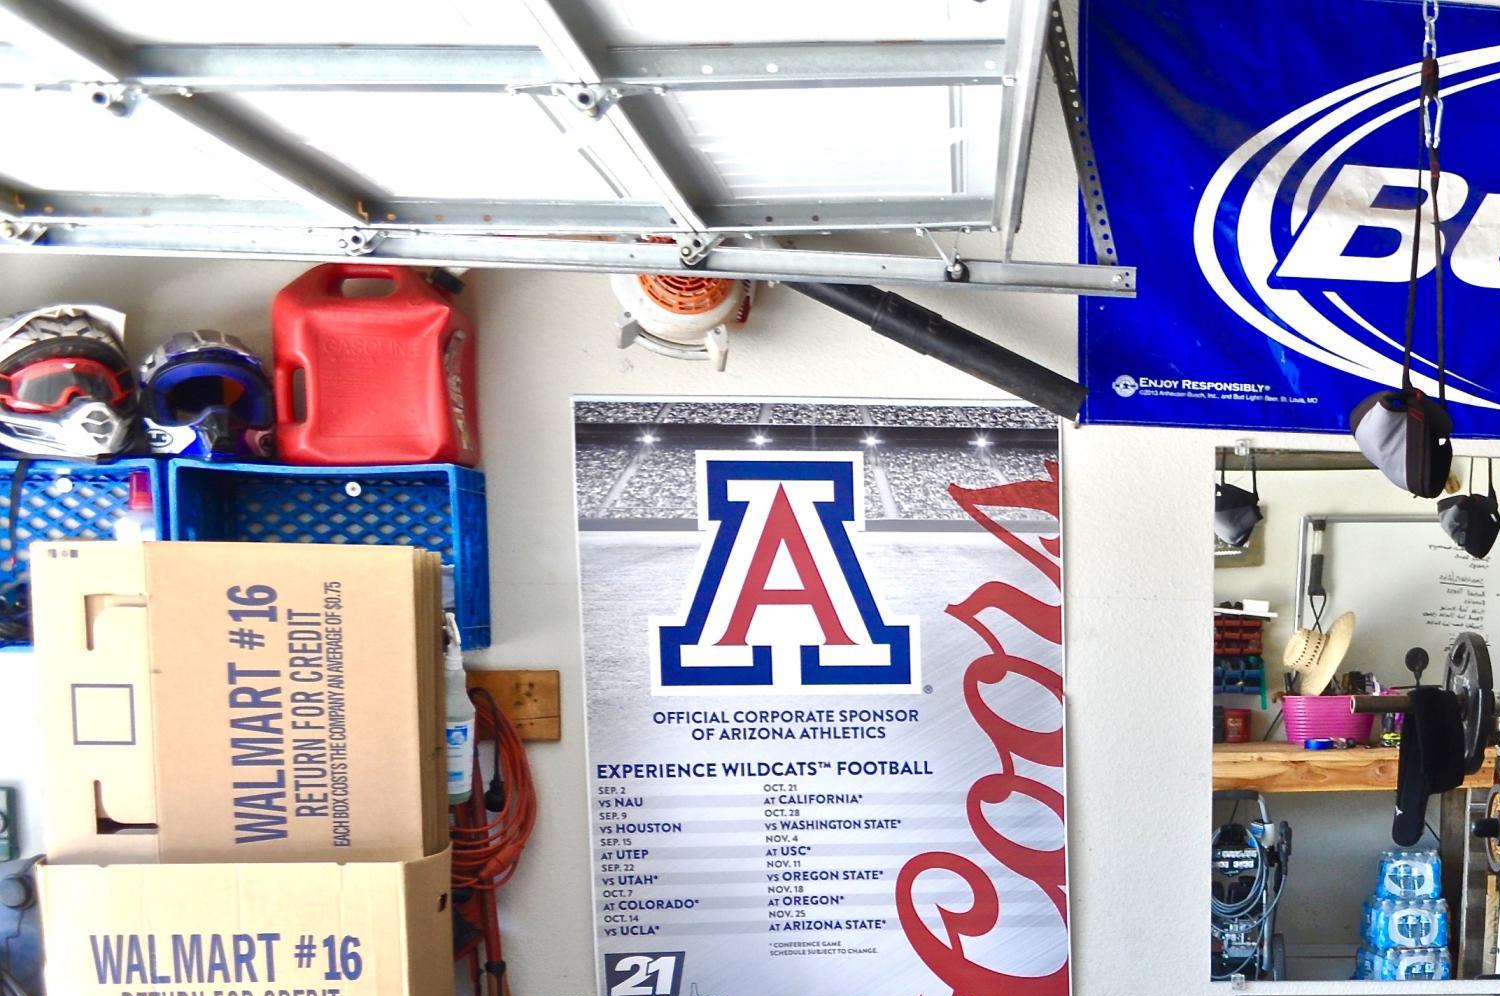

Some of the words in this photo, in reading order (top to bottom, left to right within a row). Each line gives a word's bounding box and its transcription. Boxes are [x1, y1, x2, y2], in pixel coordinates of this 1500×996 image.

[1139, 377, 1179, 389] ENJOY
[655, 455, 915, 690] A
[323, 581, 342, 610] $0.75
[324, 611, 342, 626] OF
[287, 608, 323, 683] CREDIT
[325, 627, 343, 674] AVERAGE
[326, 674, 344, 690] AN
[289, 691, 326, 730] FOR
[327, 690, 346, 741] COMPANY
[653, 711, 729, 725] OFFICIAL
[733, 710, 835, 724] CORPORATE
[839, 709, 919, 723] SPONSOR
[692, 728, 715, 741] OF
[719, 727, 796, 740] ARIZONA
[800, 726, 886, 740] ATHLETICS
[228, 662, 288, 845] WALMART
[328, 742, 347, 761] THE
[597, 763, 717, 779] EXPERIENCE
[837, 760, 933, 776] FOOTBALL
[292, 738, 329, 818] RETURN
[330, 763, 348, 797] COSTS
[598, 787, 618, 795] SEP.
[619, 786, 626, 795] 2
[763, 784, 787, 792] OCT.
[788, 784, 797, 792] 21
[598, 800, 611, 808] VS
[614, 797, 643, 808] NAU
[763, 797, 775, 805] AT
[331, 798, 349, 819] BOX
[764, 809, 787, 817] OCT.
[789, 809, 800, 817] 28
[599, 812, 620, 820] SEP.
[621, 812, 627, 820] 9
[600, 826, 612, 834] VS
[616, 823, 682, 833] HOUSTON
[764, 823, 777, 831] VS
[780, 820, 862, 830] WASHINGTON
[332, 821, 351, 847] EACH
[765, 835, 790, 843] NOV.
[792, 835, 798, 843] 4
[600, 838, 620, 846] SEP.
[622, 838, 632, 846] 15
[600, 852, 613, 860] AT
[616, 850, 649, 860] UTEP
[766, 849, 777, 857] AT
[601, 864, 622, 872] SEP.
[623, 864, 634, 872] 22
[767, 860, 791, 868] NOV.
[793, 860, 801, 868] 11
[602, 878, 615, 886] VS
[767, 874, 779, 882] VS
[782, 871, 839, 881] OREGON
[602, 890, 626, 898] OCT.
[627, 889, 633, 897] 7
[767, 886, 792, 894] NOV.
[603, 903, 615, 911] AT
[768, 898, 780, 906] AT
[604, 915, 627, 923] OCT.
[629, 914, 639, 923] 14
[769, 910, 793, 918] NOV.
[795, 910, 806, 918] 25
[769, 923, 780, 932] AT
[783, 920, 843, 931] ARIZONA
[604, 928, 617, 936] VS
[773, 941, 820, 949] CONFERENCE
[808, 948, 836, 956] SUBJECT
[89, 932, 280, 985] WALMART
[611, 955, 676, 996] 21
